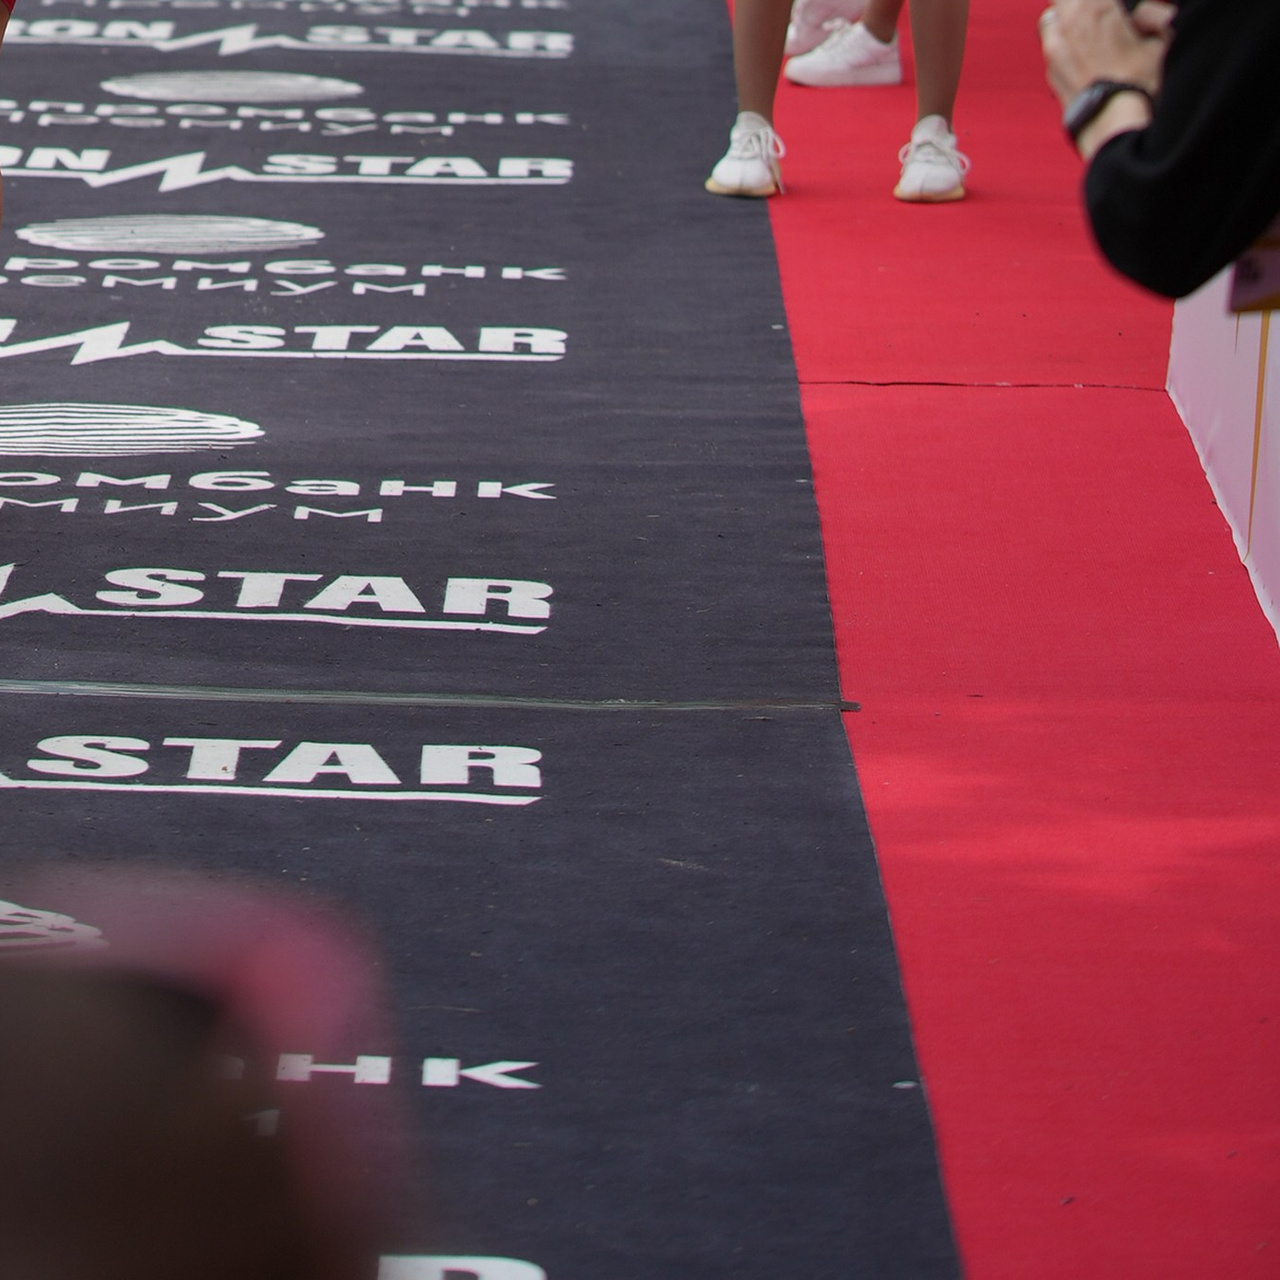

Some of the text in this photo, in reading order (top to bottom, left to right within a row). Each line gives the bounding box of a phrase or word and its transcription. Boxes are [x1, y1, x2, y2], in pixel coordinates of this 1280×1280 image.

[305, 24, 574, 53] STAR
[262, 153, 574, 179] STAR
[198, 325, 568, 355] STAR
[95, 566, 556, 620] STAR
[24, 733, 544, 788] STAR
